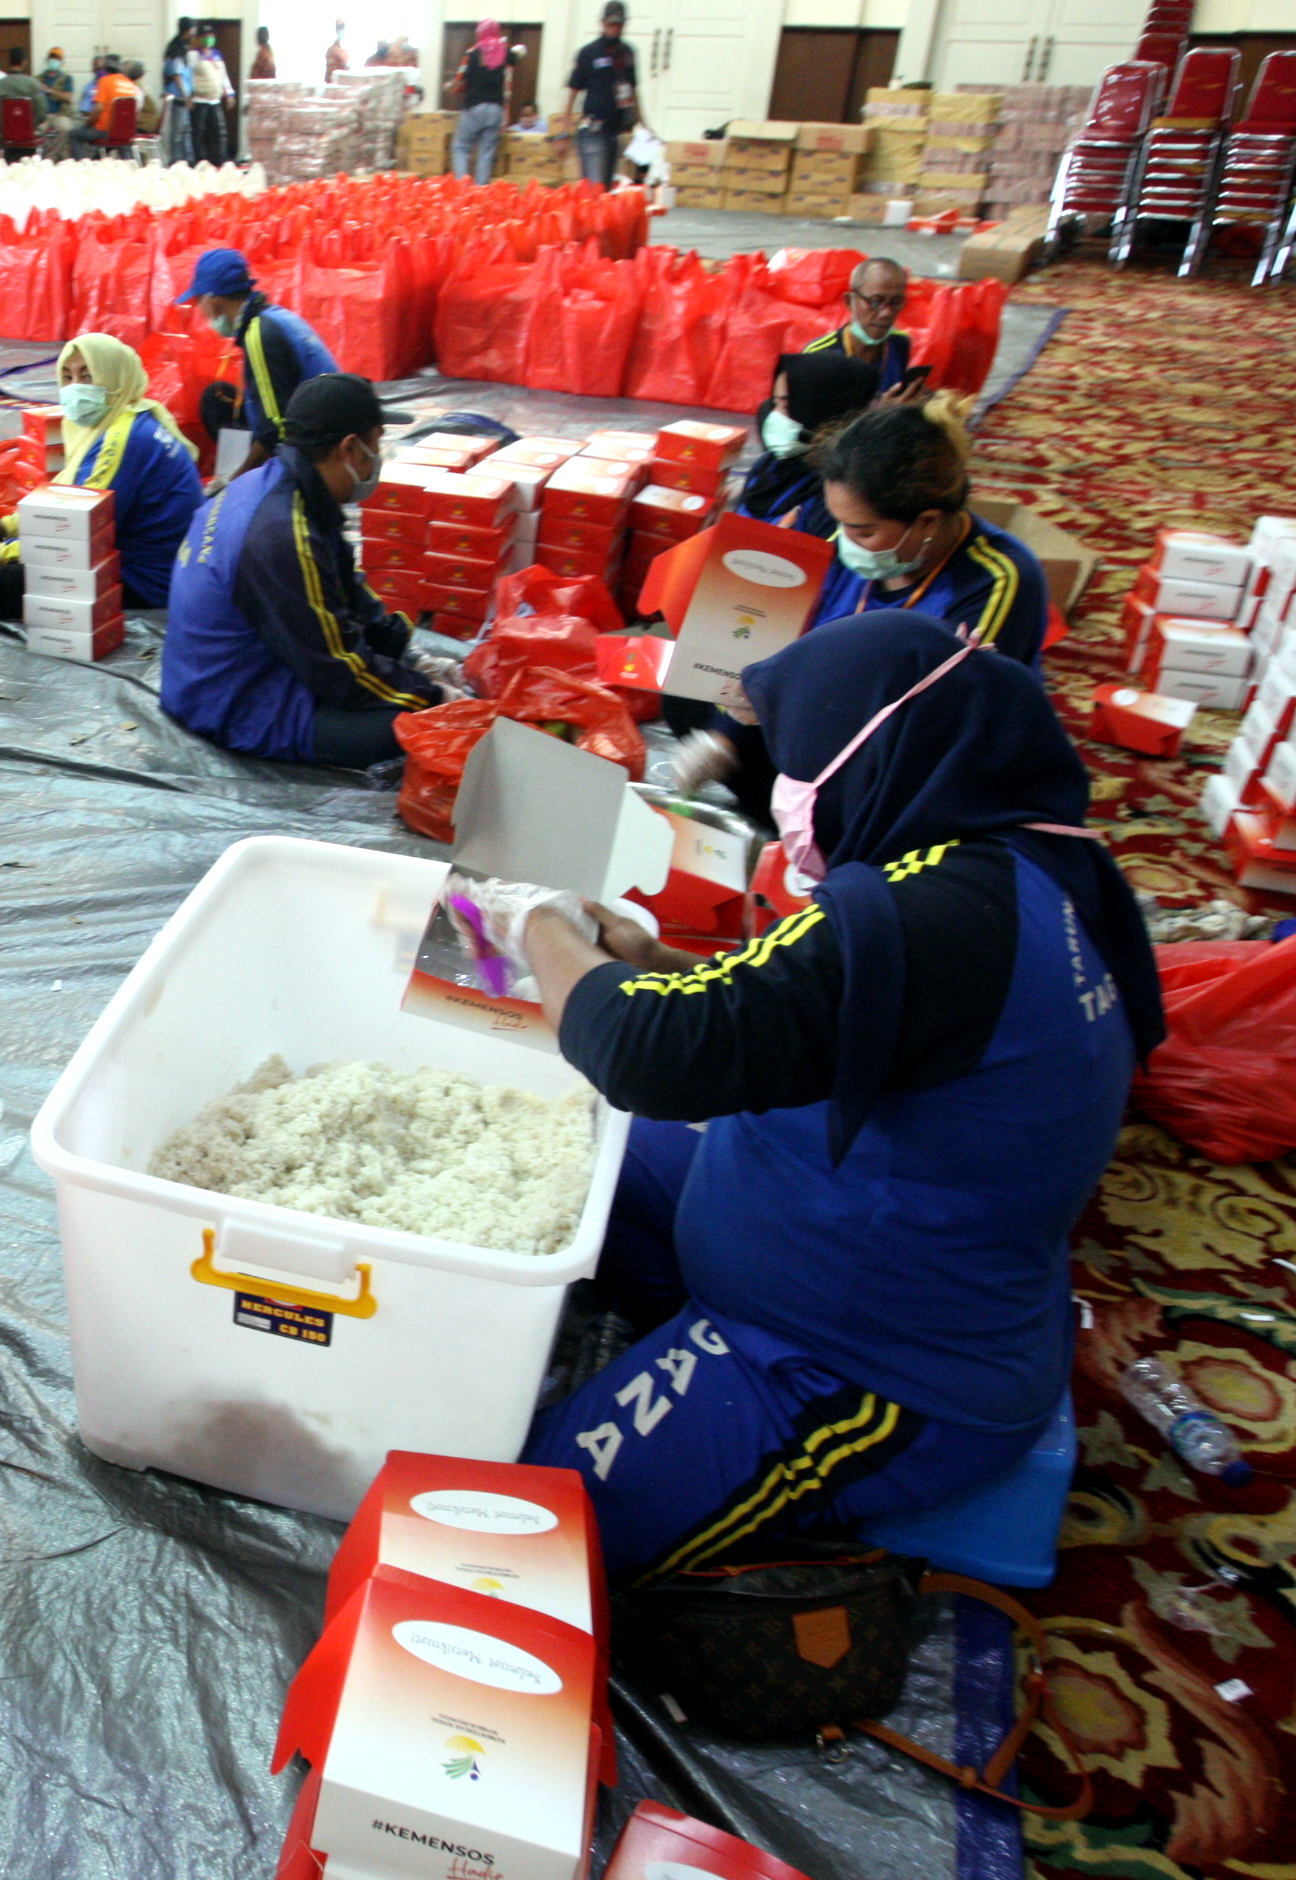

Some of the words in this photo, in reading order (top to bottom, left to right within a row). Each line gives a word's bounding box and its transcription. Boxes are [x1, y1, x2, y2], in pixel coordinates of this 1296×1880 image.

[693, 662, 742, 681] #KEMENSO
[1062, 894, 1087, 989] TARUN
[240, 1299, 326, 1327] HERCULES
[278, 1323, 299, 1336] CB
[372, 1819, 496, 1866] #KEMENSOS
